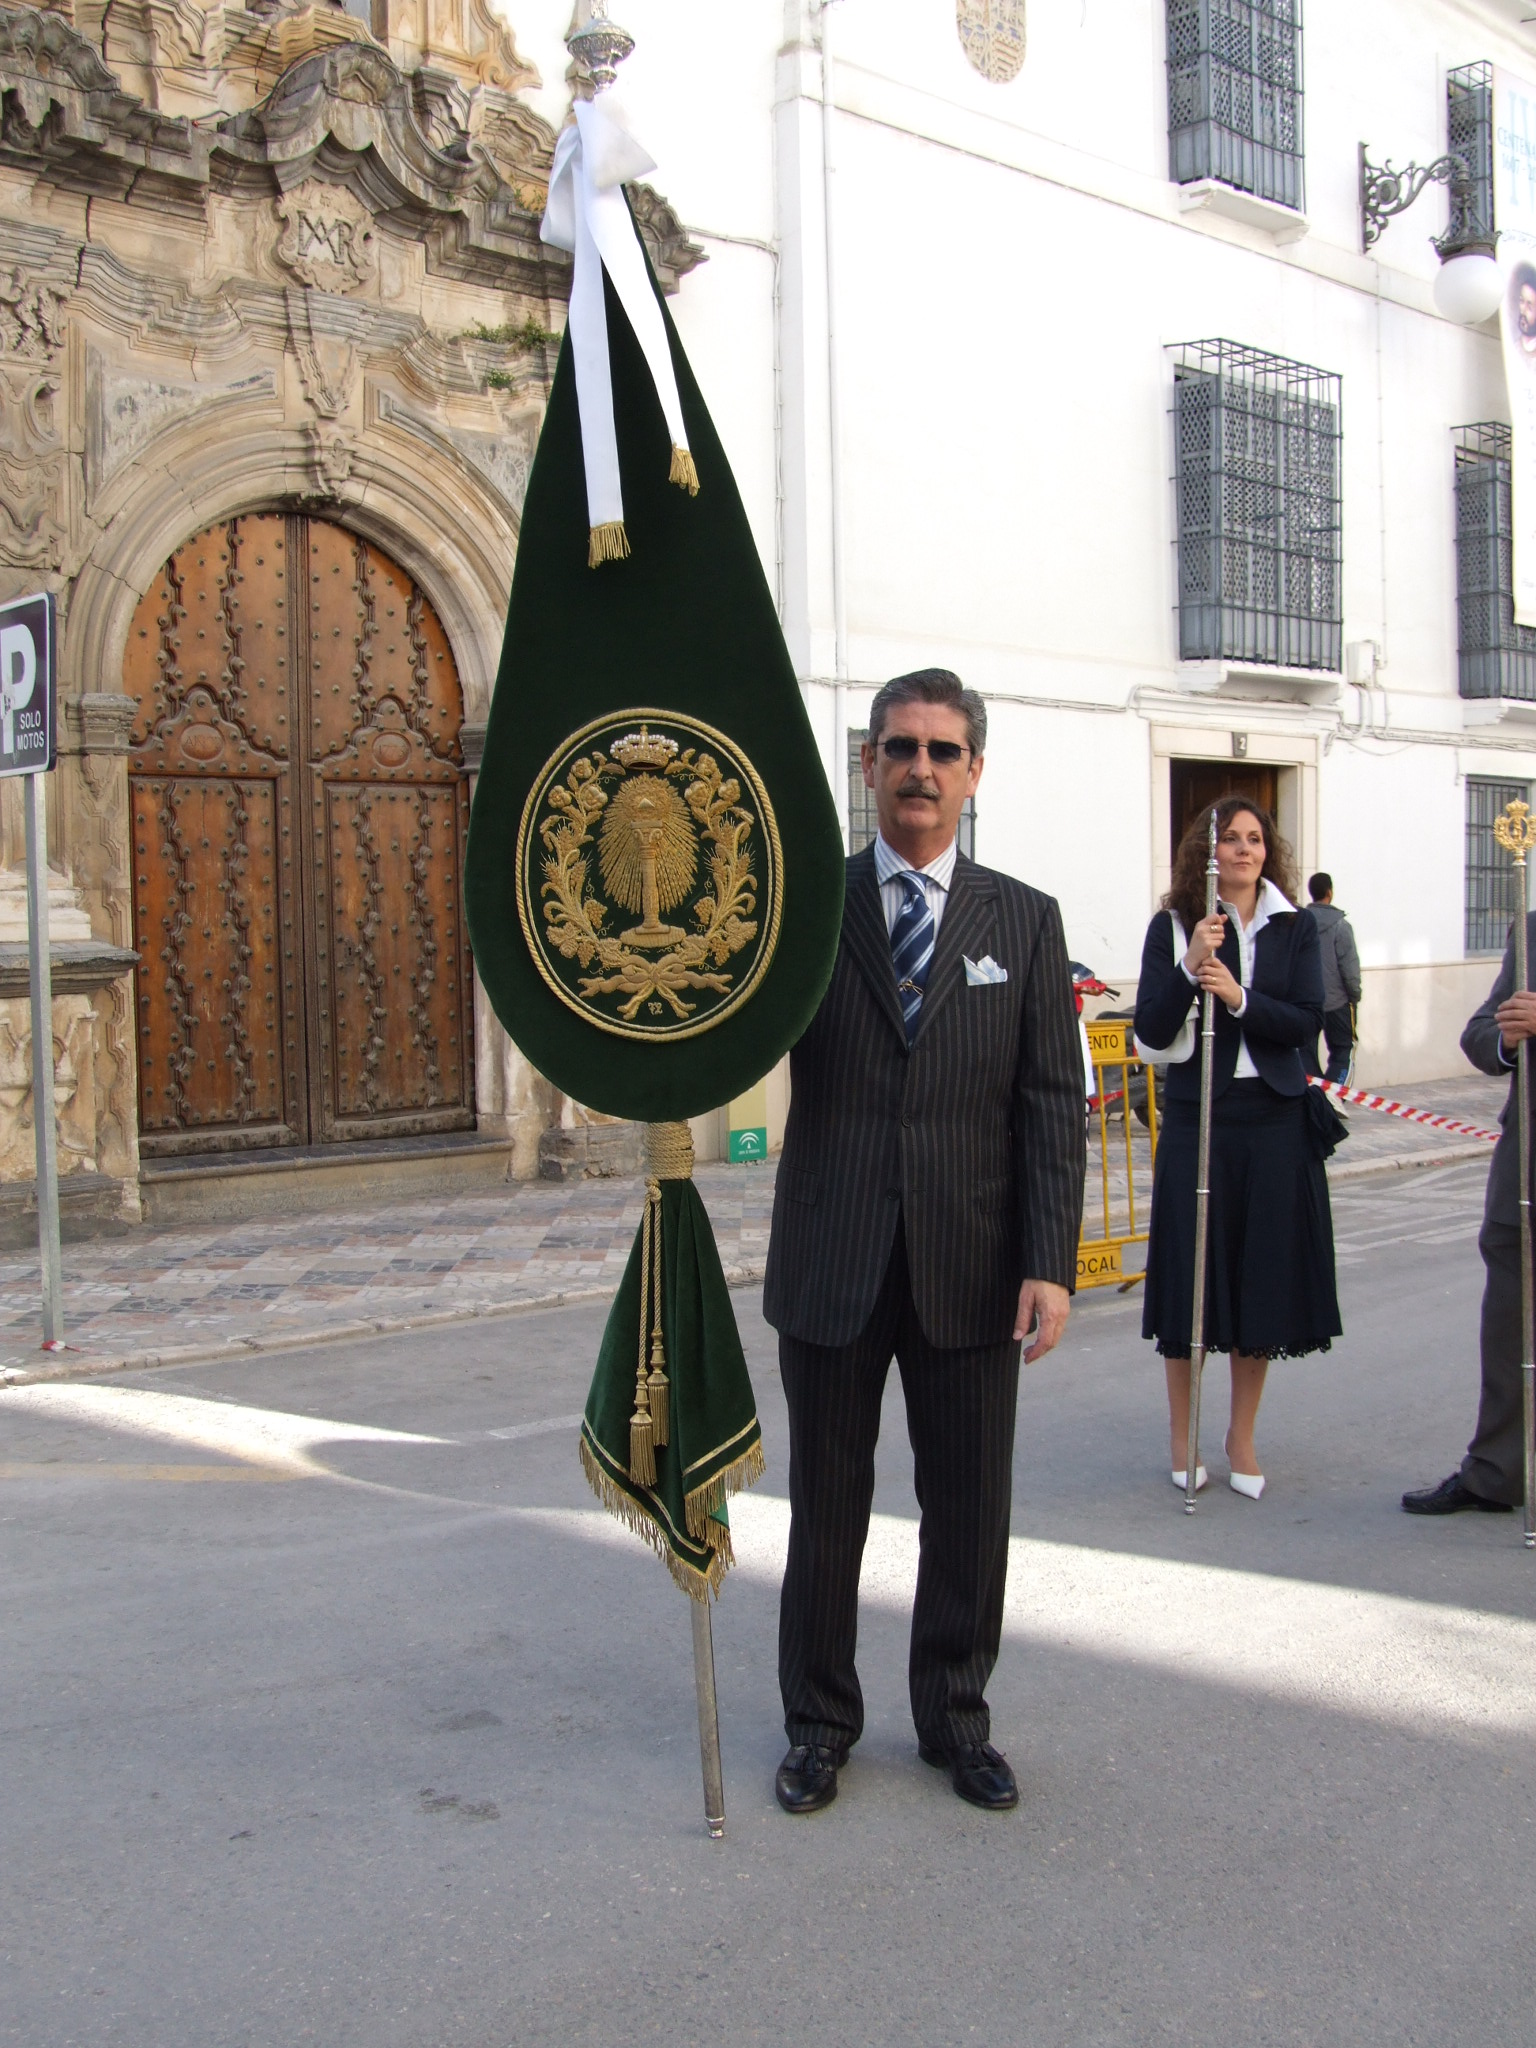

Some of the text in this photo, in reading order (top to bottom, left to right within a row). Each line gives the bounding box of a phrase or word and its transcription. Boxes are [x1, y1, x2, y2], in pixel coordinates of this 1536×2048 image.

[1, 624, 37, 755] P
[20, 710, 41, 730] SOLO
[17, 731, 44, 750] MOTOS
[1240, 736, 1247, 750] 2
[1076, 1255, 1117, 1276] OCAL
